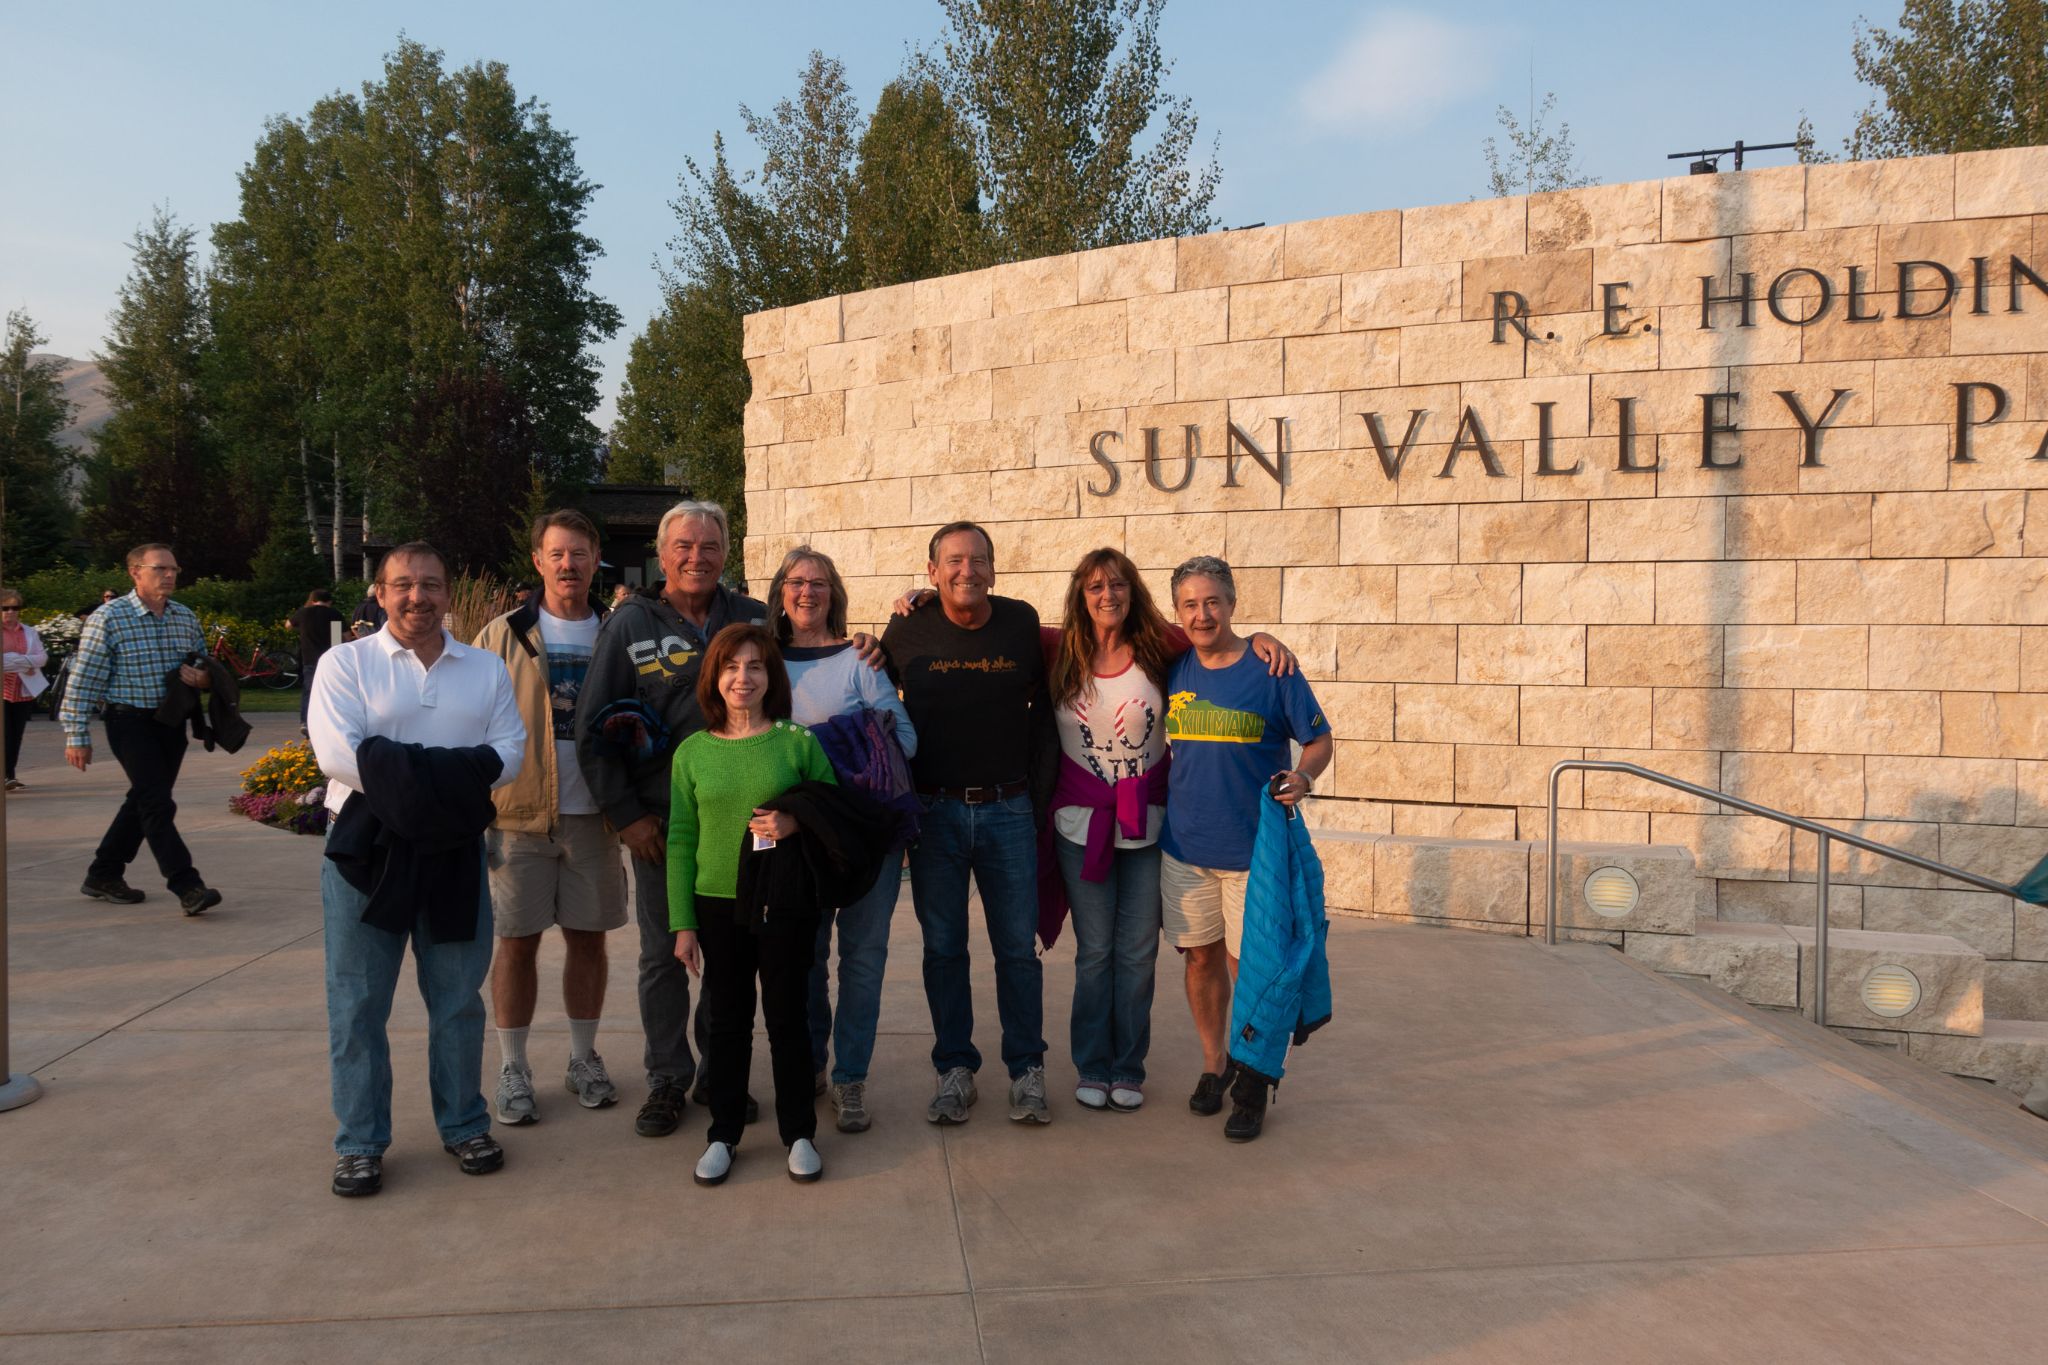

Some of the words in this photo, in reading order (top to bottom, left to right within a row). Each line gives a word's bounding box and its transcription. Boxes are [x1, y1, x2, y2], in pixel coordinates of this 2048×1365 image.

[1488, 290, 1555, 343] R.
[1598, 281, 1652, 336] E.
[1696, 254, 2048, 330] HOLDIN
[1087, 416, 1289, 497] SUN
[1355, 388, 1853, 482] VALLEY
